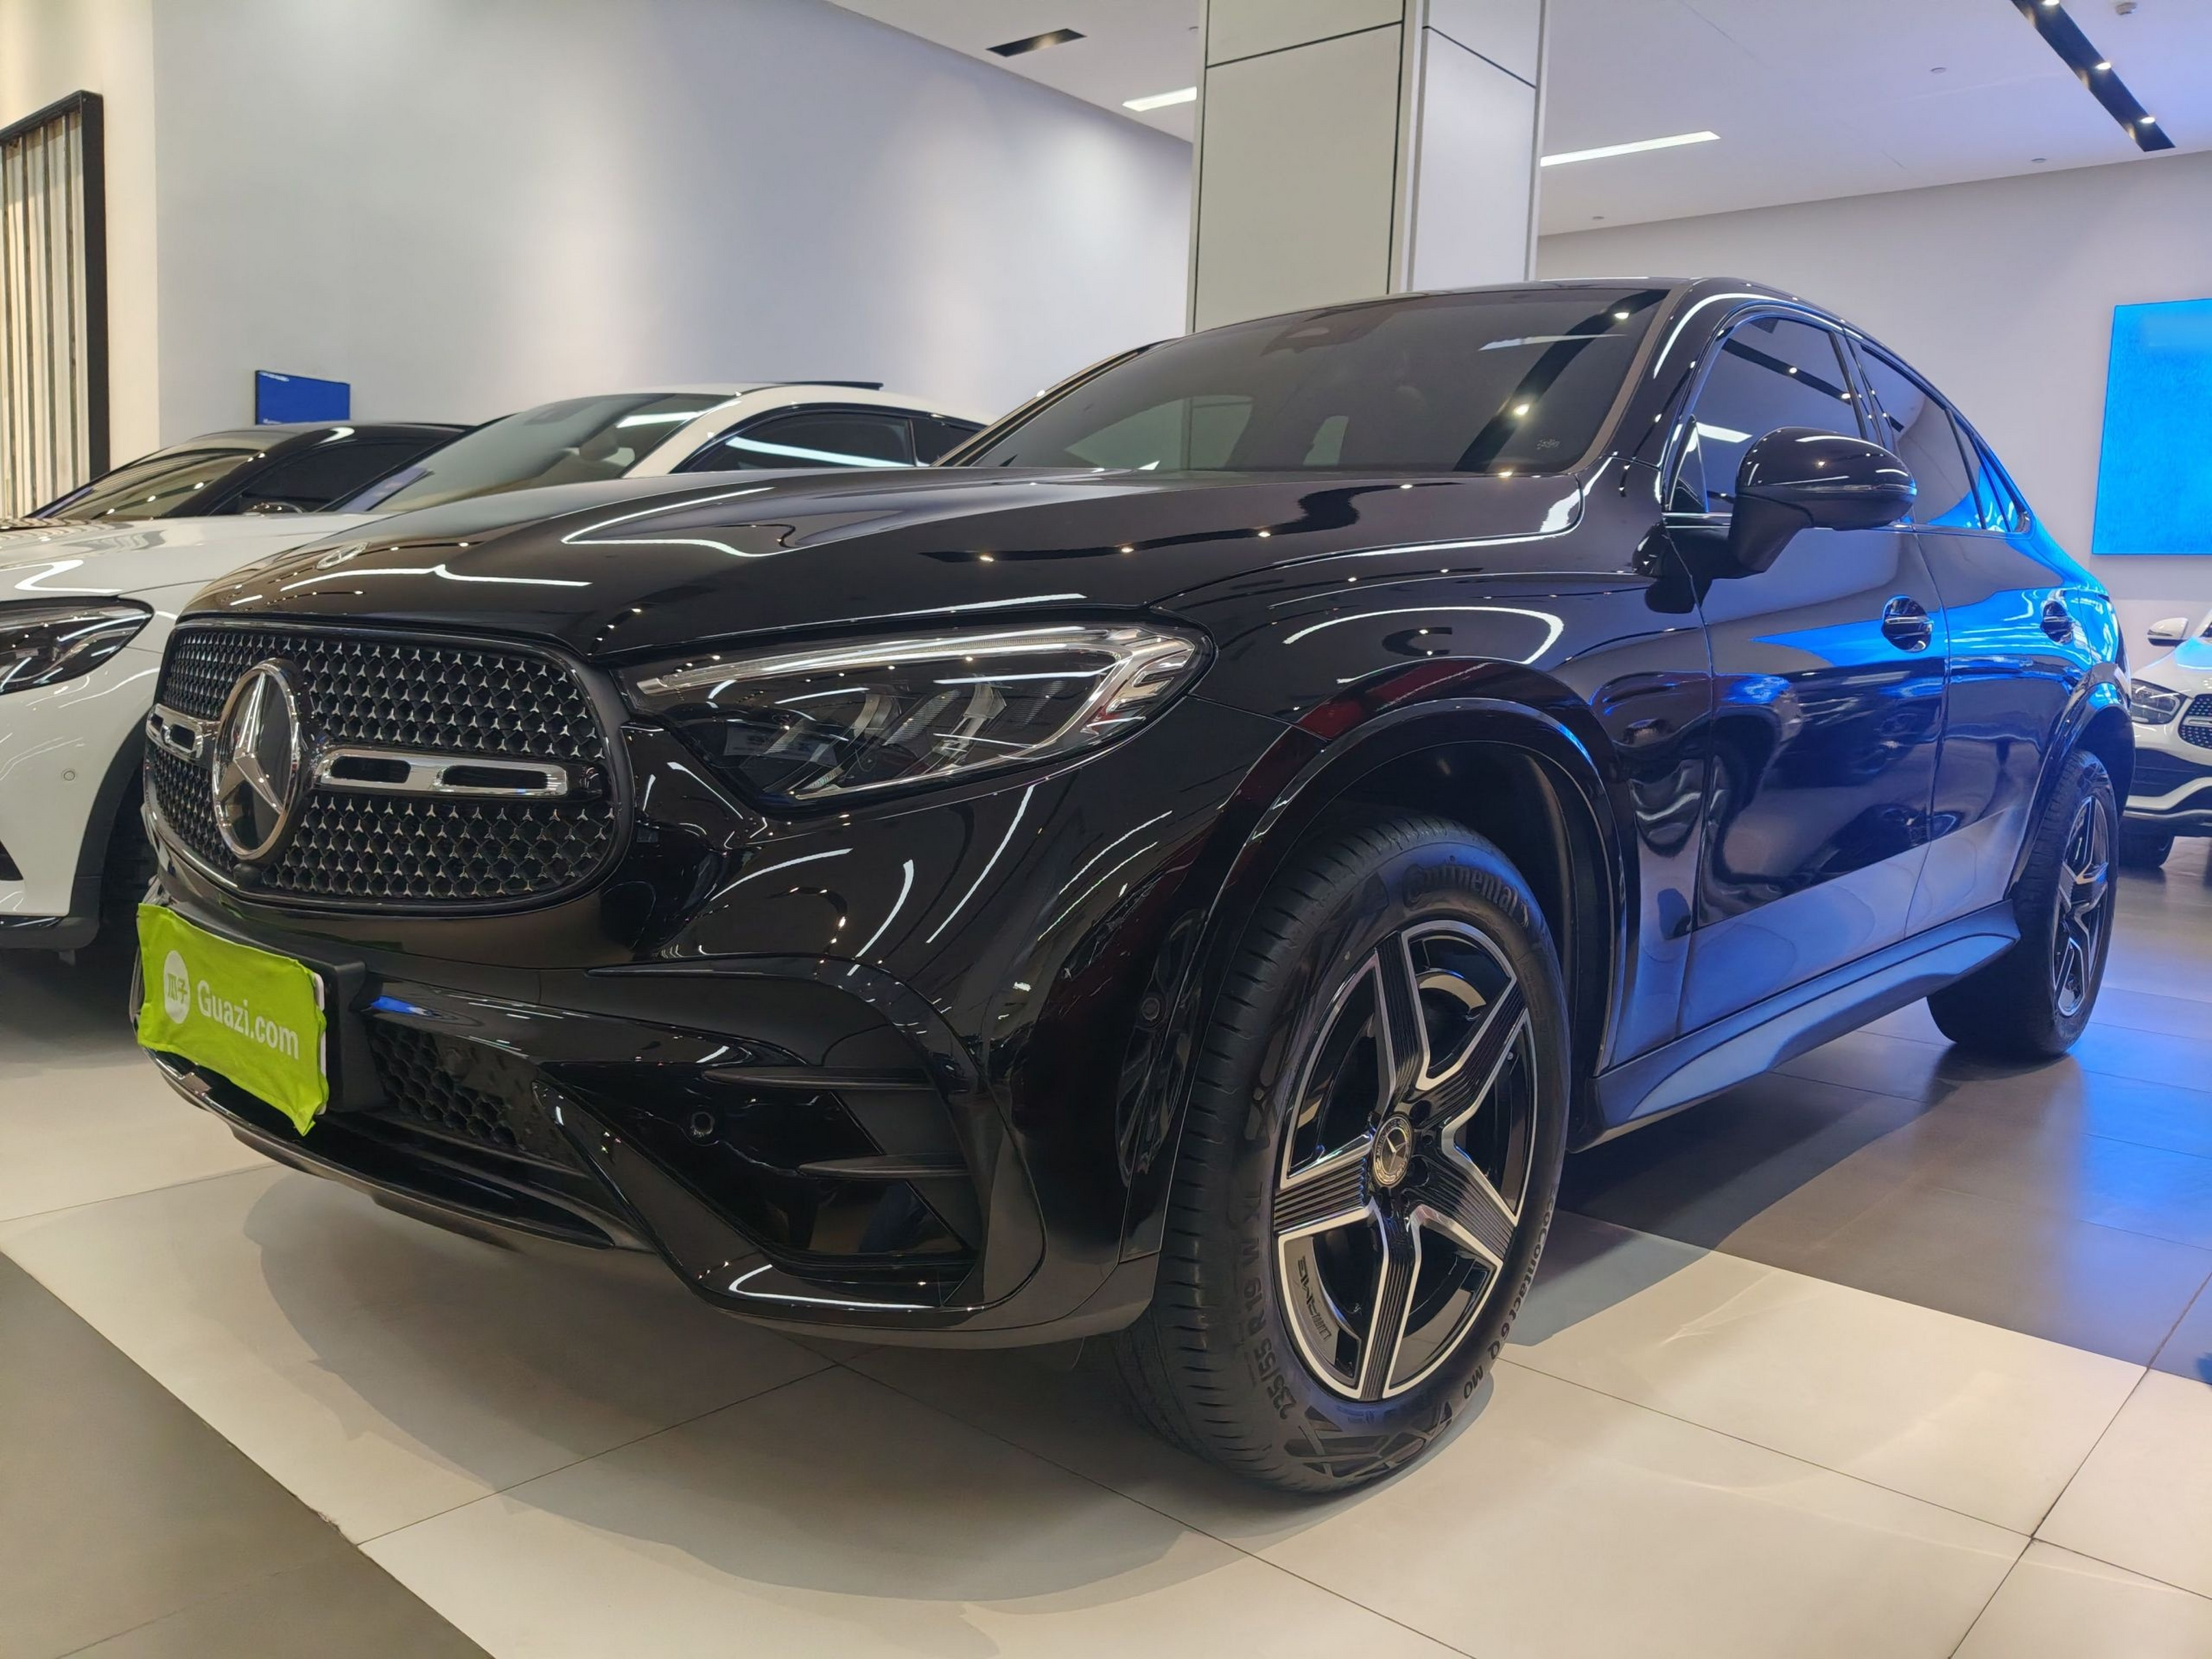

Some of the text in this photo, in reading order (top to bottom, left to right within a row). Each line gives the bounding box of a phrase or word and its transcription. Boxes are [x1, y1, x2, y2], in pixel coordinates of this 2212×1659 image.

[198, 980, 300, 1060] Guazi.com
[1241, 1277, 1263, 1311] 19
[1297, 1255, 1319, 1316] AMG
[1247, 1309, 1266, 1336] R
[1253, 1338, 1297, 1421] 235/55
[1463, 1365, 1483, 1399] MO
